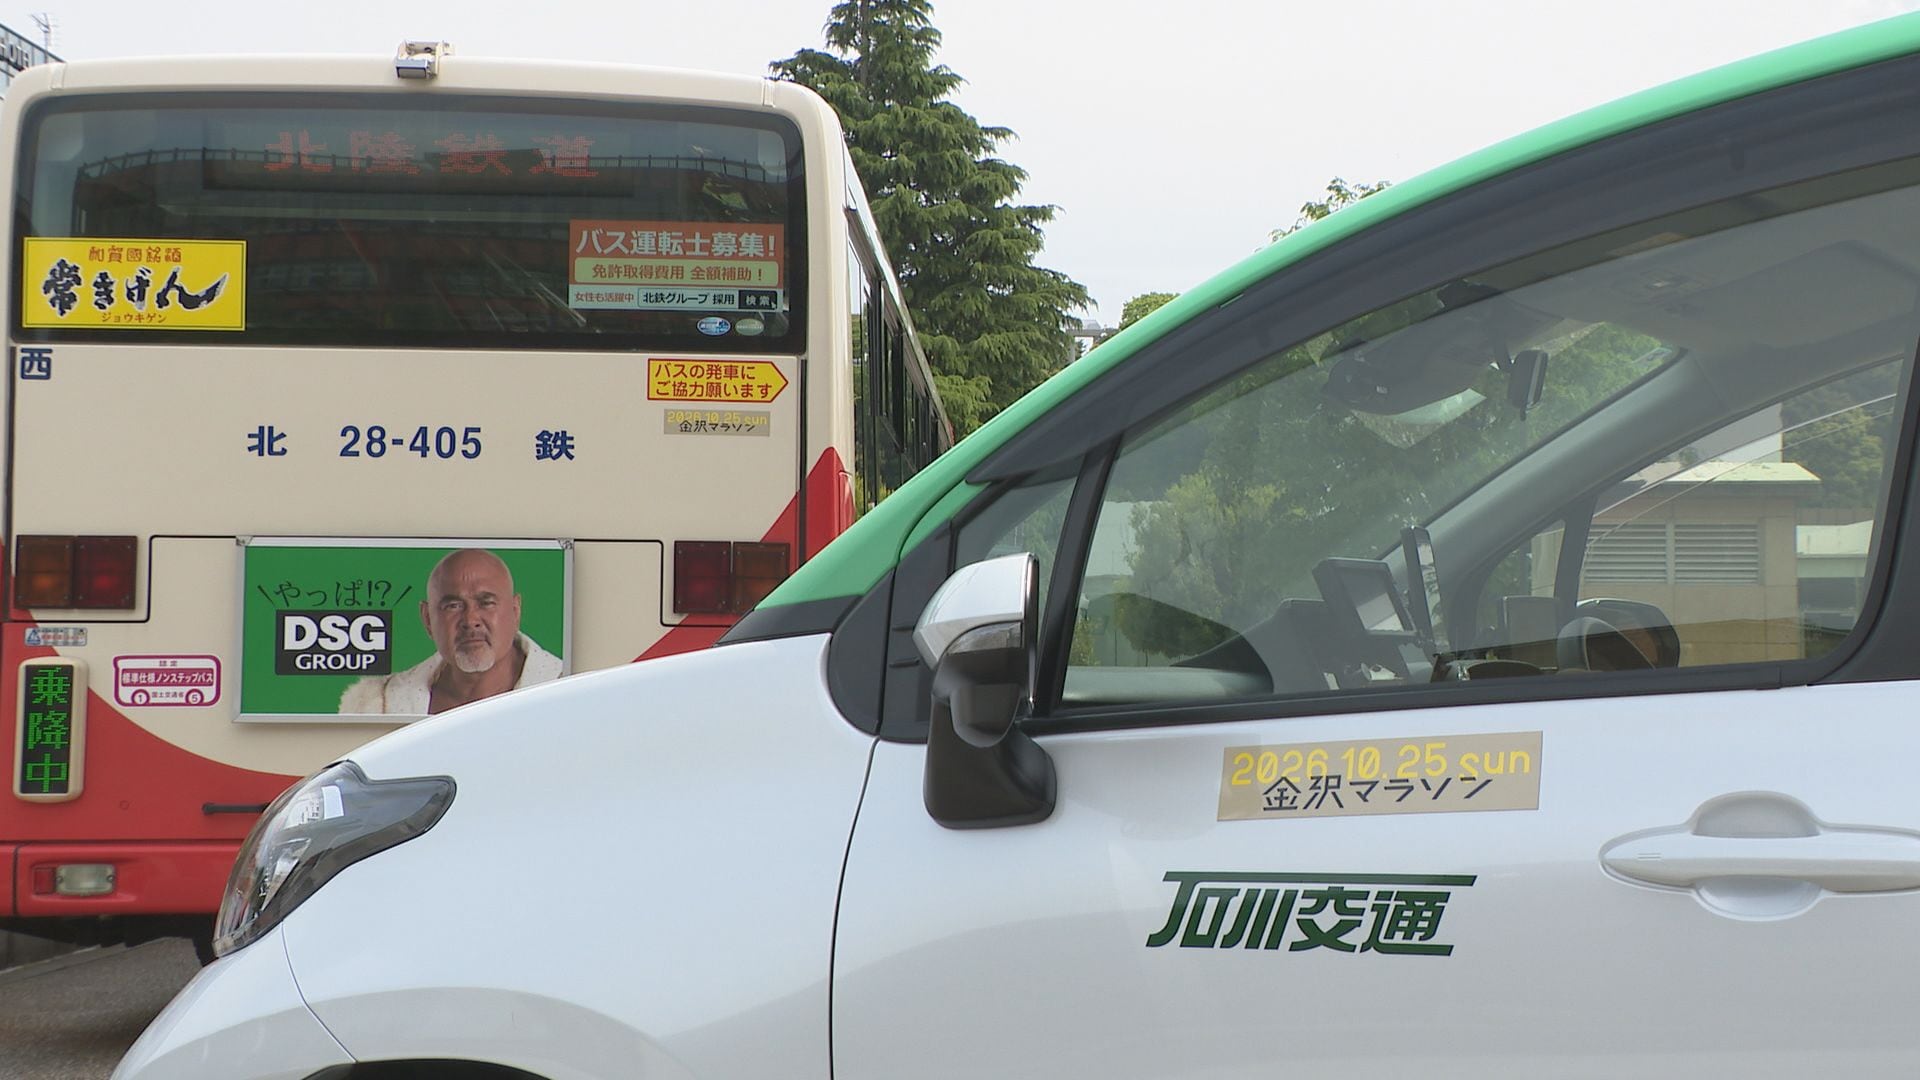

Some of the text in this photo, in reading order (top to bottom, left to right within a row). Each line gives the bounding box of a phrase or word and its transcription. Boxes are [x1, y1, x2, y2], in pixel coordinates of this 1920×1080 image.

[264, 129, 598, 178] 北陸鉄道
[575, 229, 776, 257] バス運転士募集!
[592, 264, 684, 280] 免許取得費用
[42, 258, 229, 317] 常きげん
[575, 292, 635, 303] 女性も活躍中
[642, 292, 735, 305] 北鉄グループ 採用
[745, 294, 770, 306] 検索
[101, 312, 167, 324] ジョウキゲン
[21, 348, 53, 380] 西
[655, 363, 756, 380] バスの発車に
[656, 381, 772, 399] ご協力願います
[679, 420, 756, 433] 金沢マラソン
[247, 425, 575, 461] 北 28-405 鉄
[284, 615, 386, 651] DSG
[295, 653, 376, 670] GROUP
[26, 667, 70, 792] 乗降中
[1457, 749, 1532, 784] sun
[1262, 775, 1493, 812] 金沢マラソン
[1146, 871, 1477, 956] 石川交通
